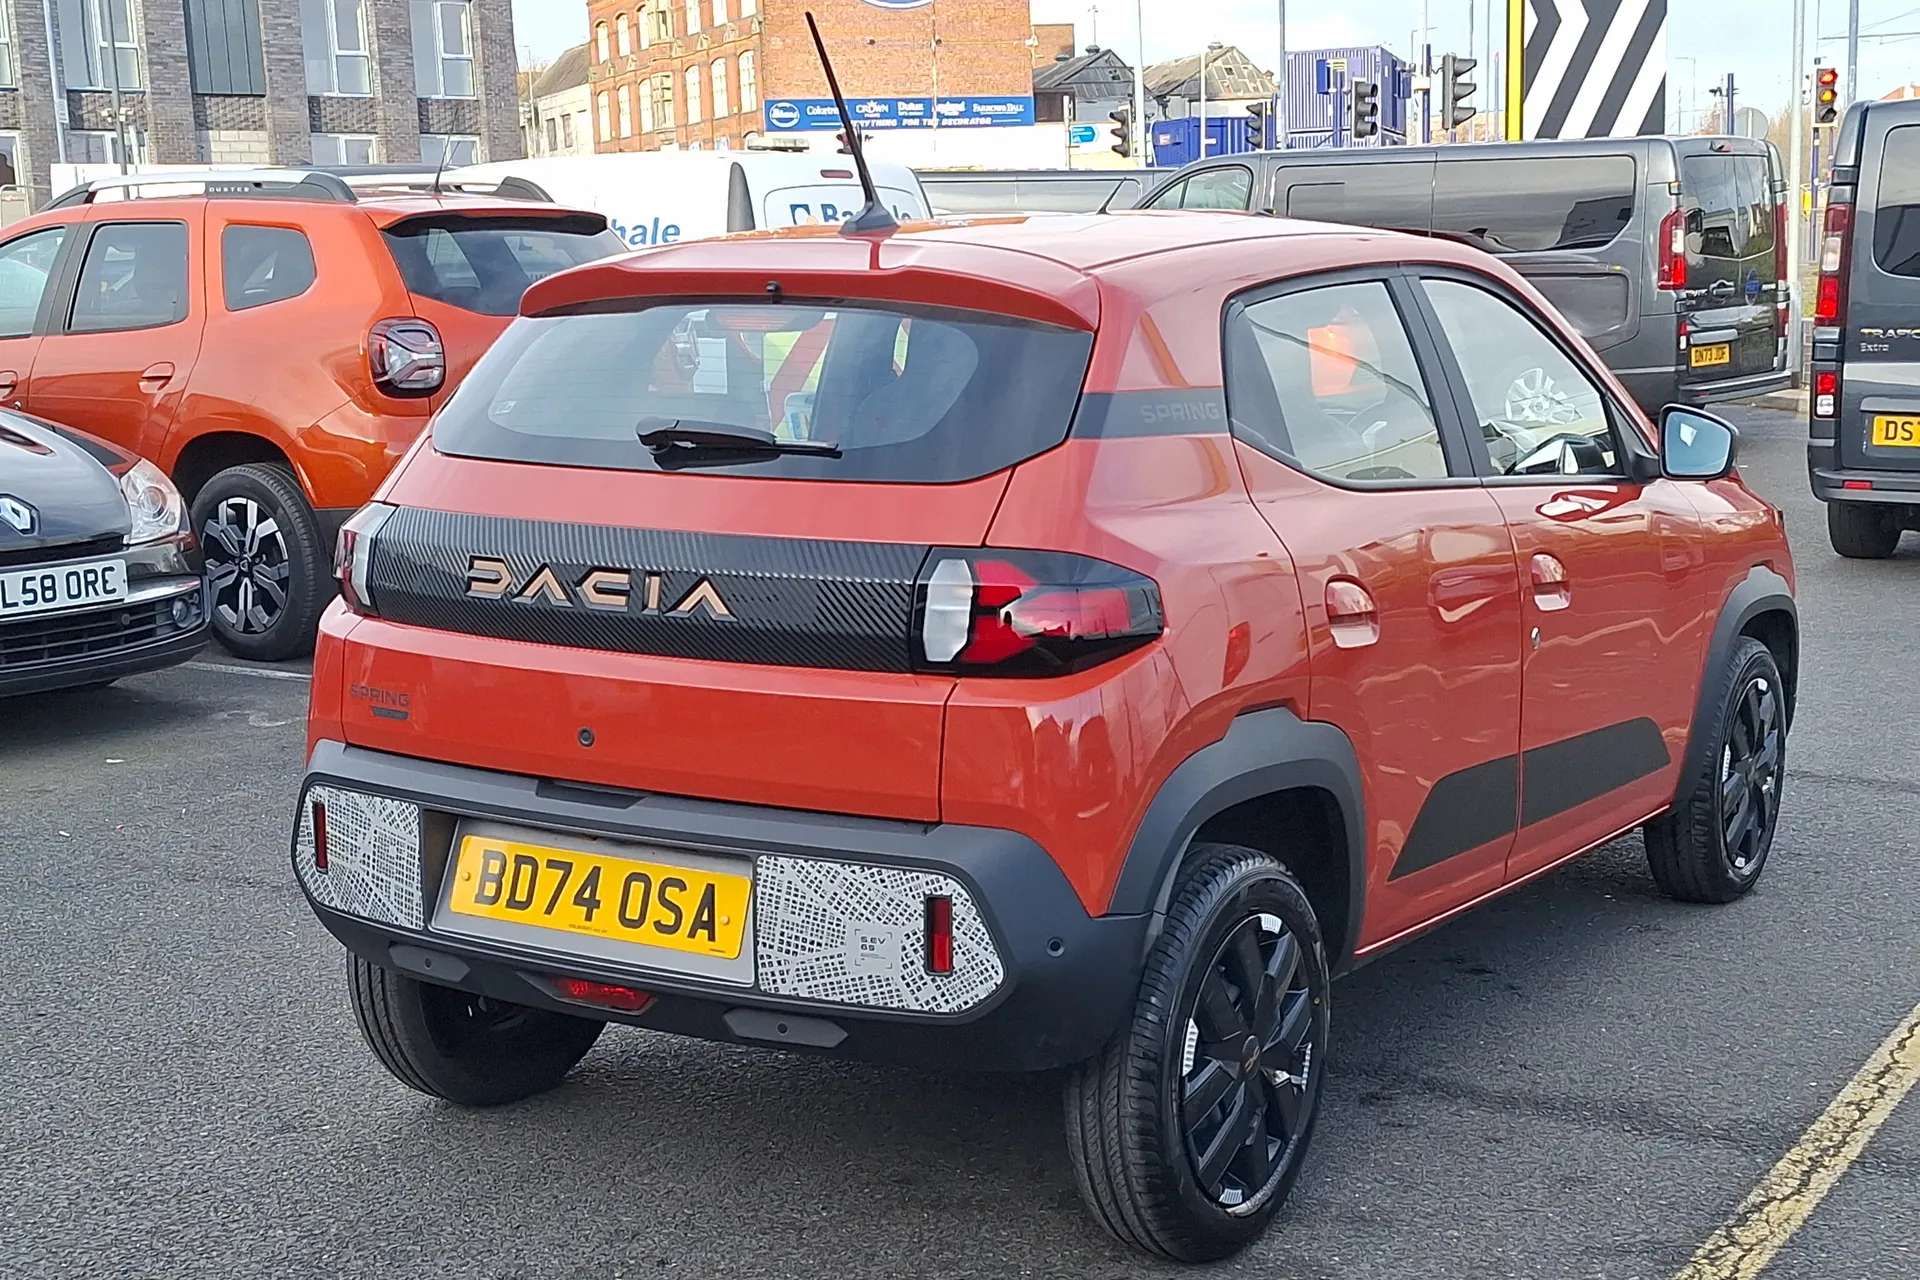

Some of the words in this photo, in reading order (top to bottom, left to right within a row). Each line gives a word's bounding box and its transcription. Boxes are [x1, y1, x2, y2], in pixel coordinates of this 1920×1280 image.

[208, 185, 250, 193] DUSTER
[1860, 342, 1889, 352] Extra
[1142, 402, 1219, 423] SPRING
[1884, 420, 1920, 441] DS
[0, 573, 58, 609] L58
[65, 566, 118, 600] ORC
[465, 554, 738, 622] DACIA
[351, 682, 410, 706] SPRING
[474, 849, 602, 922] BD74
[618, 871, 716, 942] OSA
